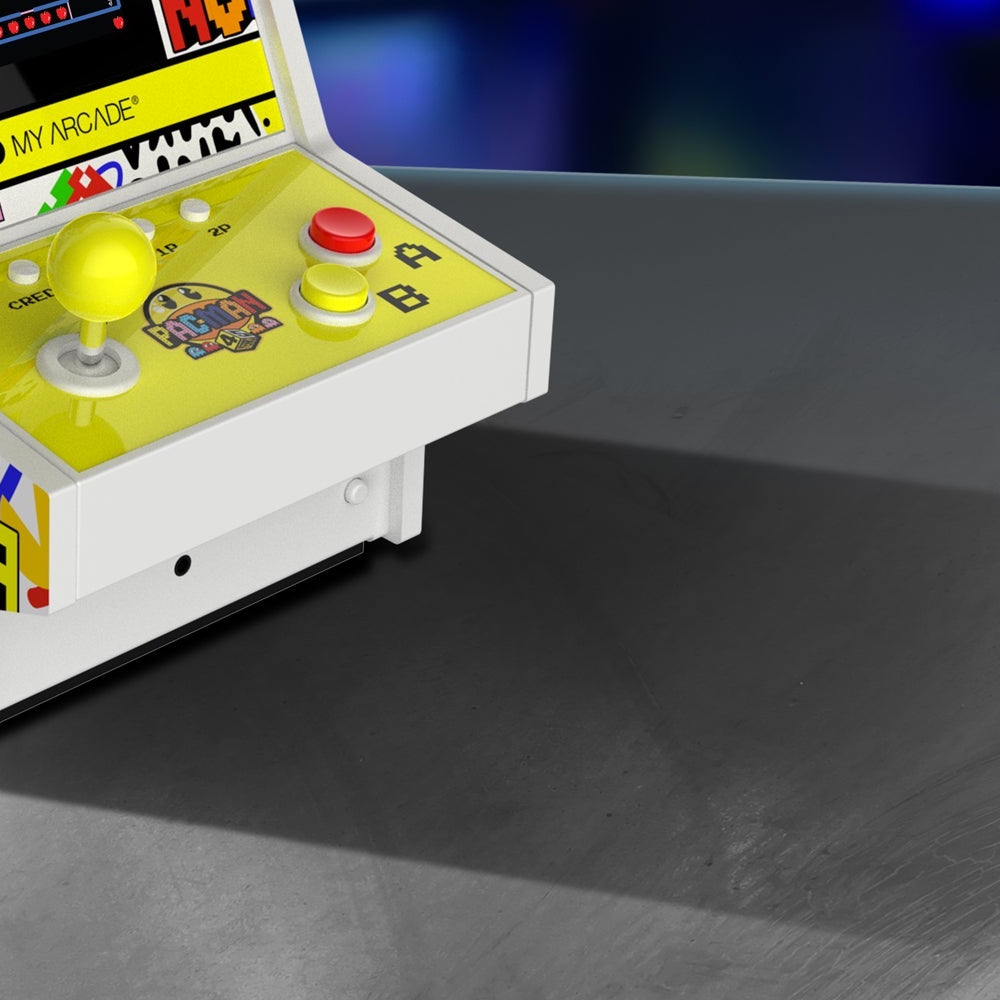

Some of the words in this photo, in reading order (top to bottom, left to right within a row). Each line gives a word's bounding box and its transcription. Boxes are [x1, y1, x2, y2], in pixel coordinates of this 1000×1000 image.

[11, 125, 43, 157] MY
[207, 223, 231, 237] 2P
[156, 243, 178, 257] 1P
[393, 242, 443, 269] A
[376, 283, 430, 313] B
